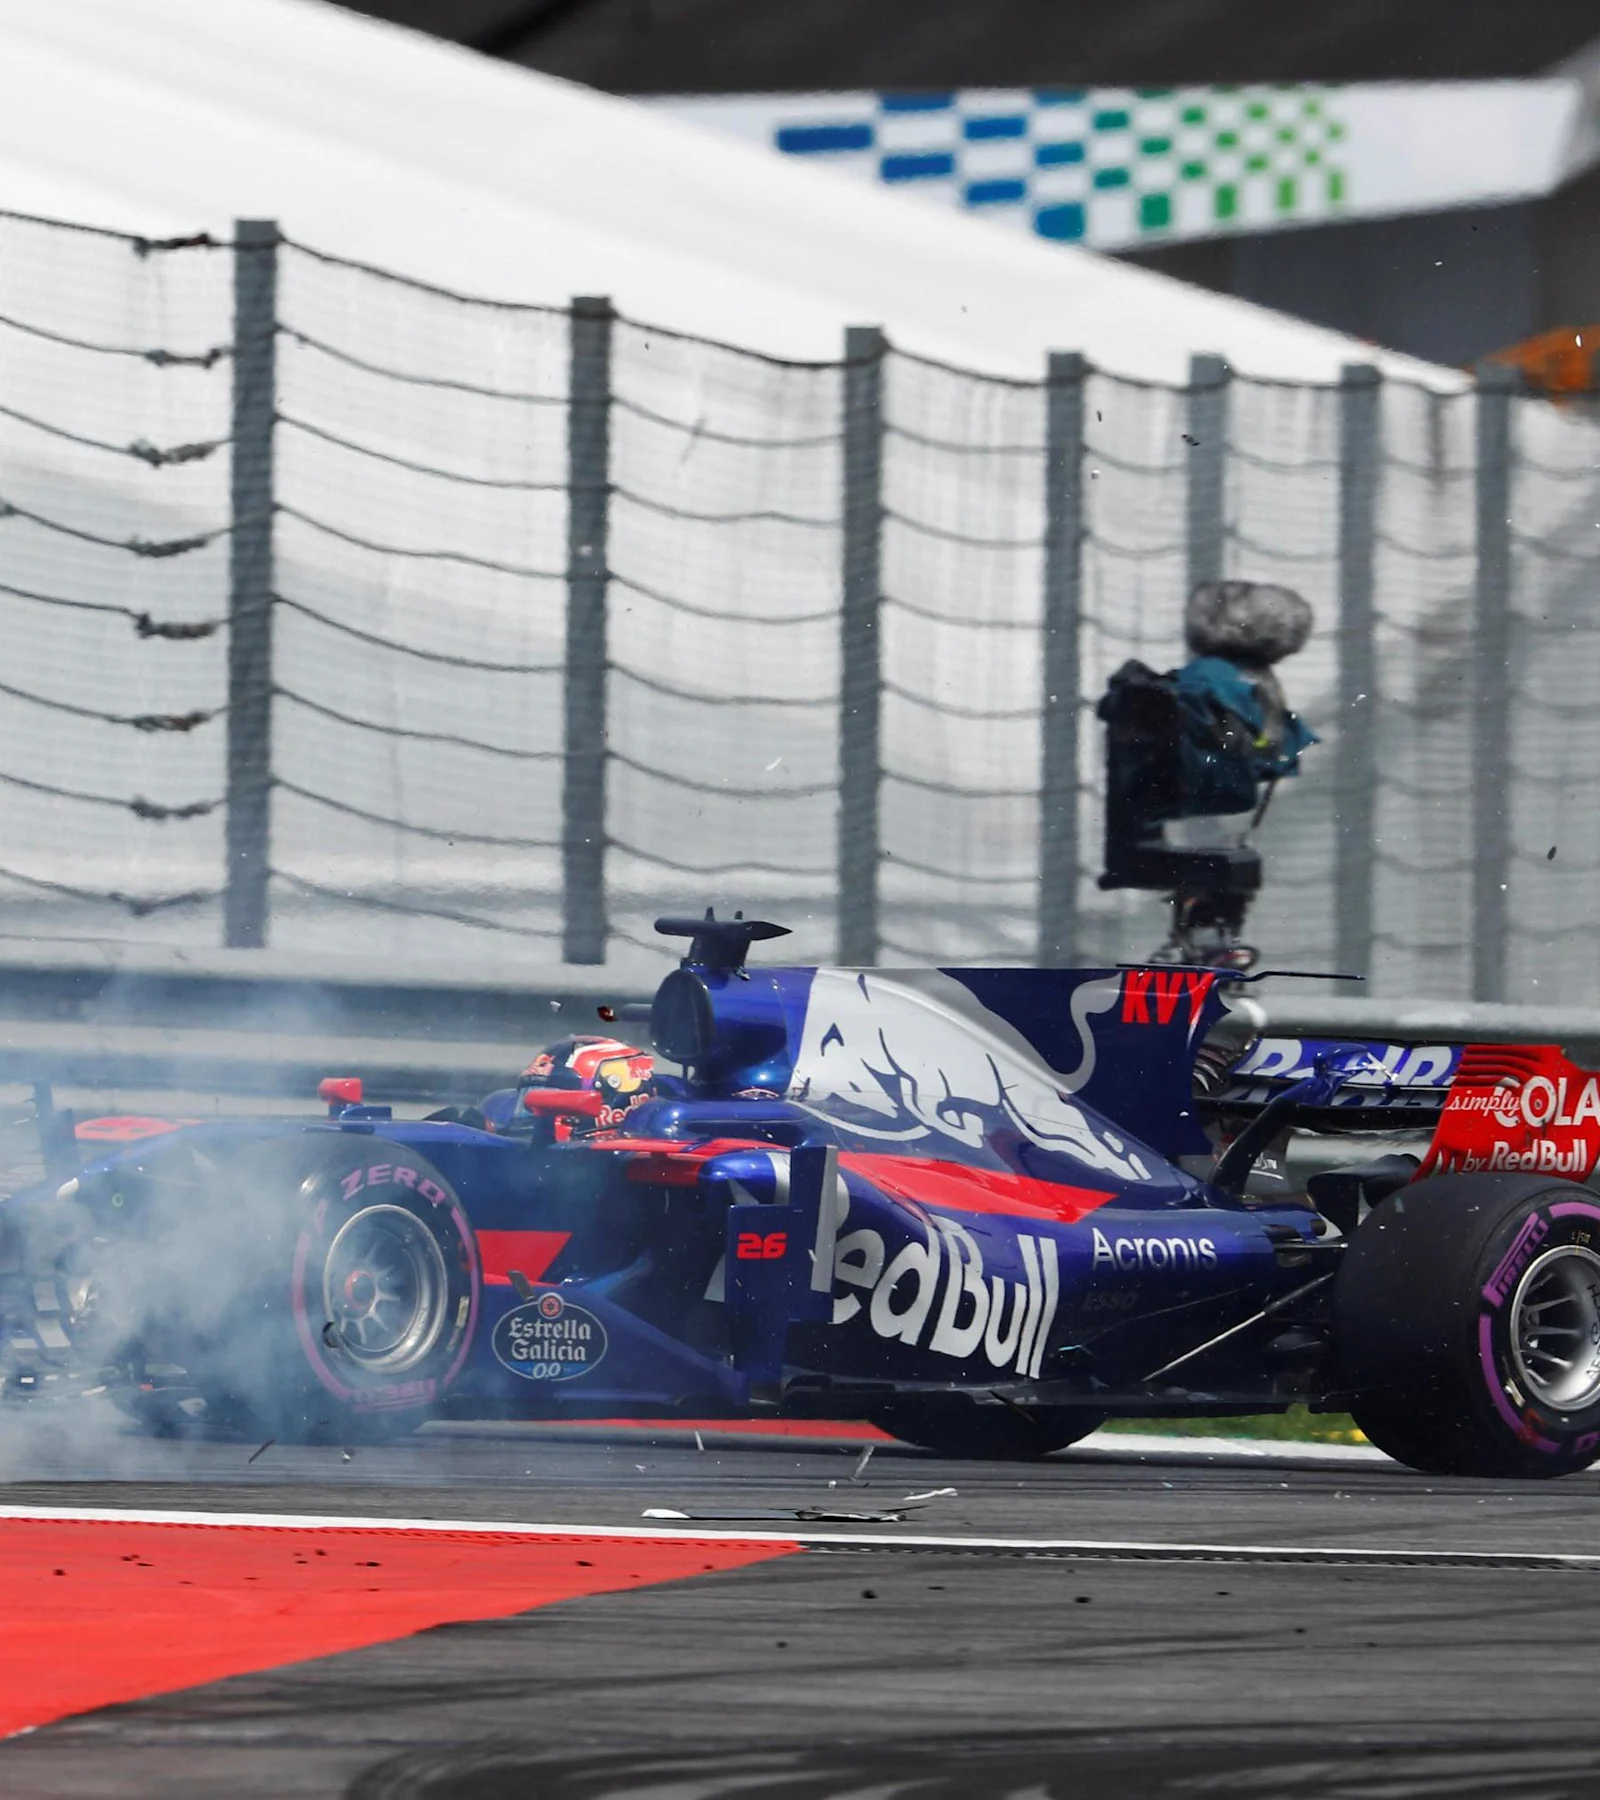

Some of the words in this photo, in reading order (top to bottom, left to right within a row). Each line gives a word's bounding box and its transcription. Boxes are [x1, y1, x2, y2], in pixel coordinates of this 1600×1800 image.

[1121, 971, 1216, 1025] KVY
[1445, 1090, 1521, 1117] simply
[1462, 1149, 1486, 1172] by
[341, 1164, 447, 1204] ZERO
[737, 1232, 788, 1260] 26
[1092, 1227, 1218, 1271] Acronis
[1481, 1211, 1549, 1308] PIRELLI
[508, 1317, 592, 1340] Estrella
[511, 1338, 587, 1361] Galicia
